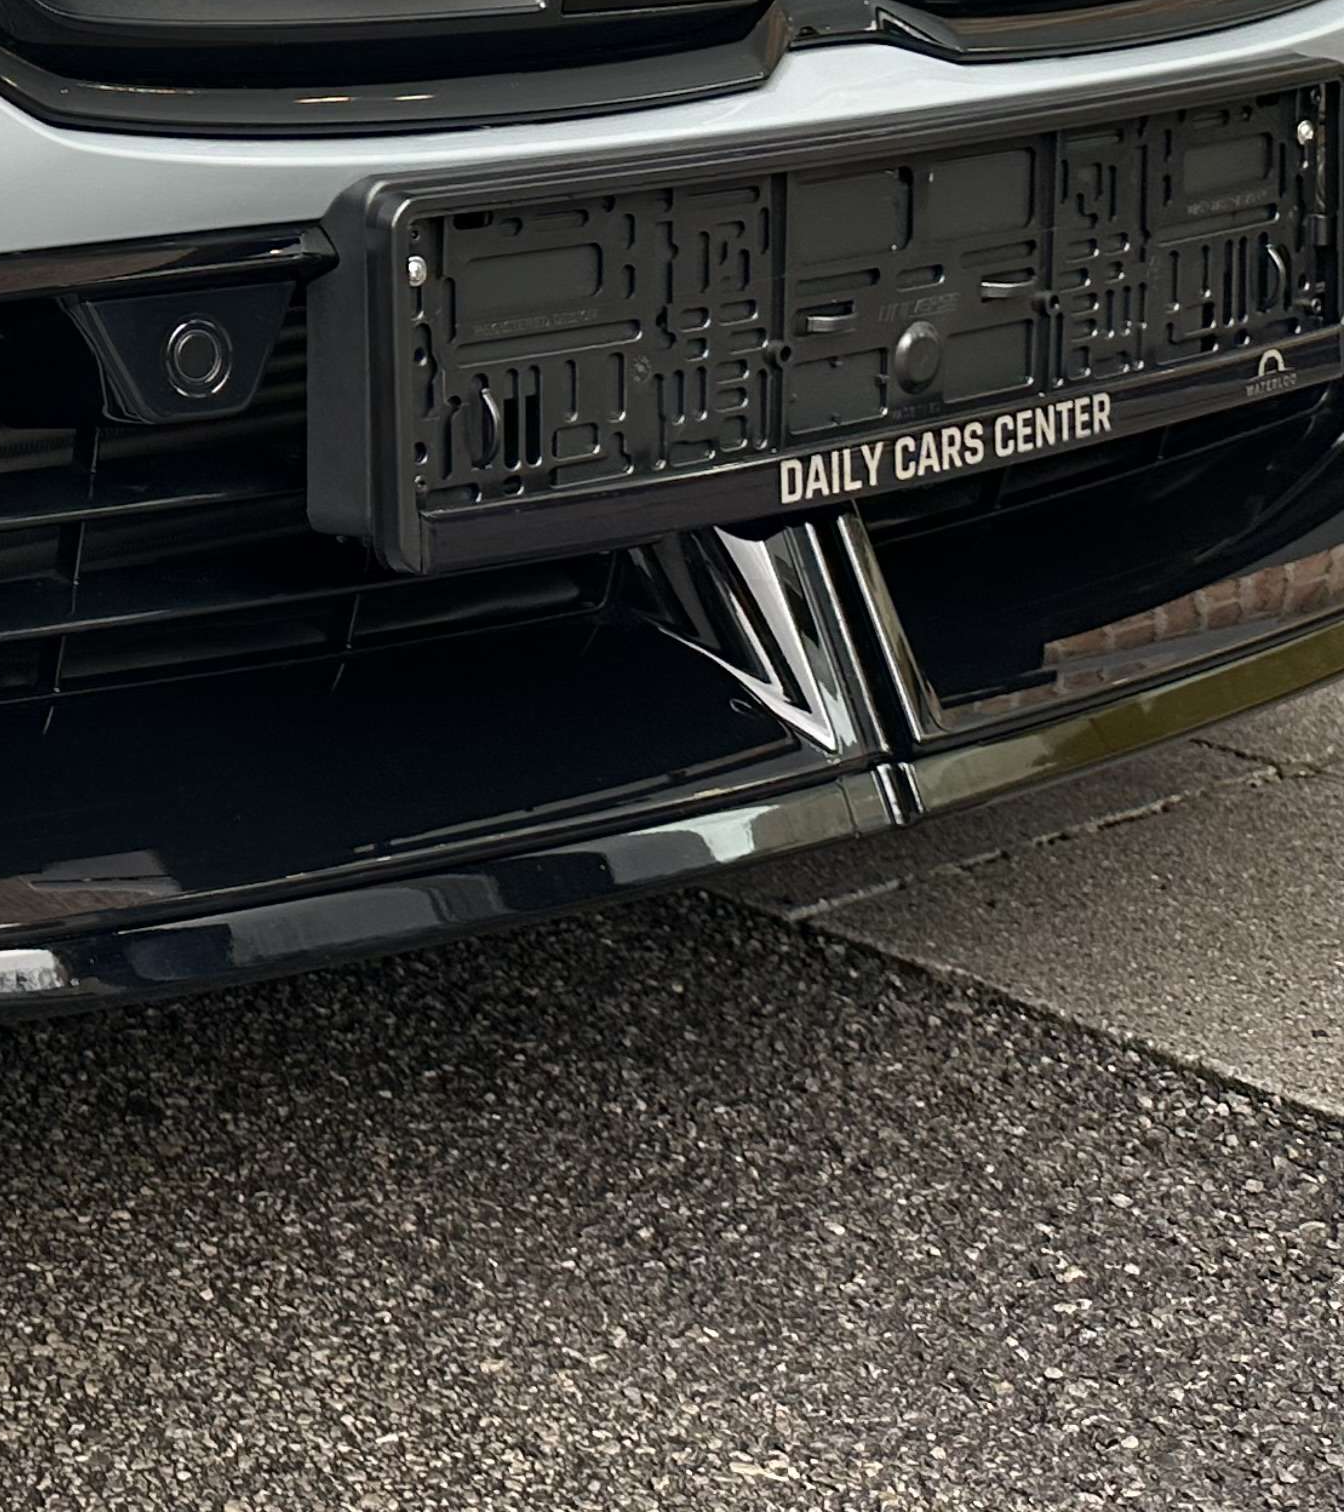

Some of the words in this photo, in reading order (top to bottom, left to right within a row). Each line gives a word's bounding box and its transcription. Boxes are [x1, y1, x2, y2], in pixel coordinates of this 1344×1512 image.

[779, 441, 885, 505] DAILY
[894, 421, 985, 482] CARS
[994, 391, 1112, 459] CENTER
